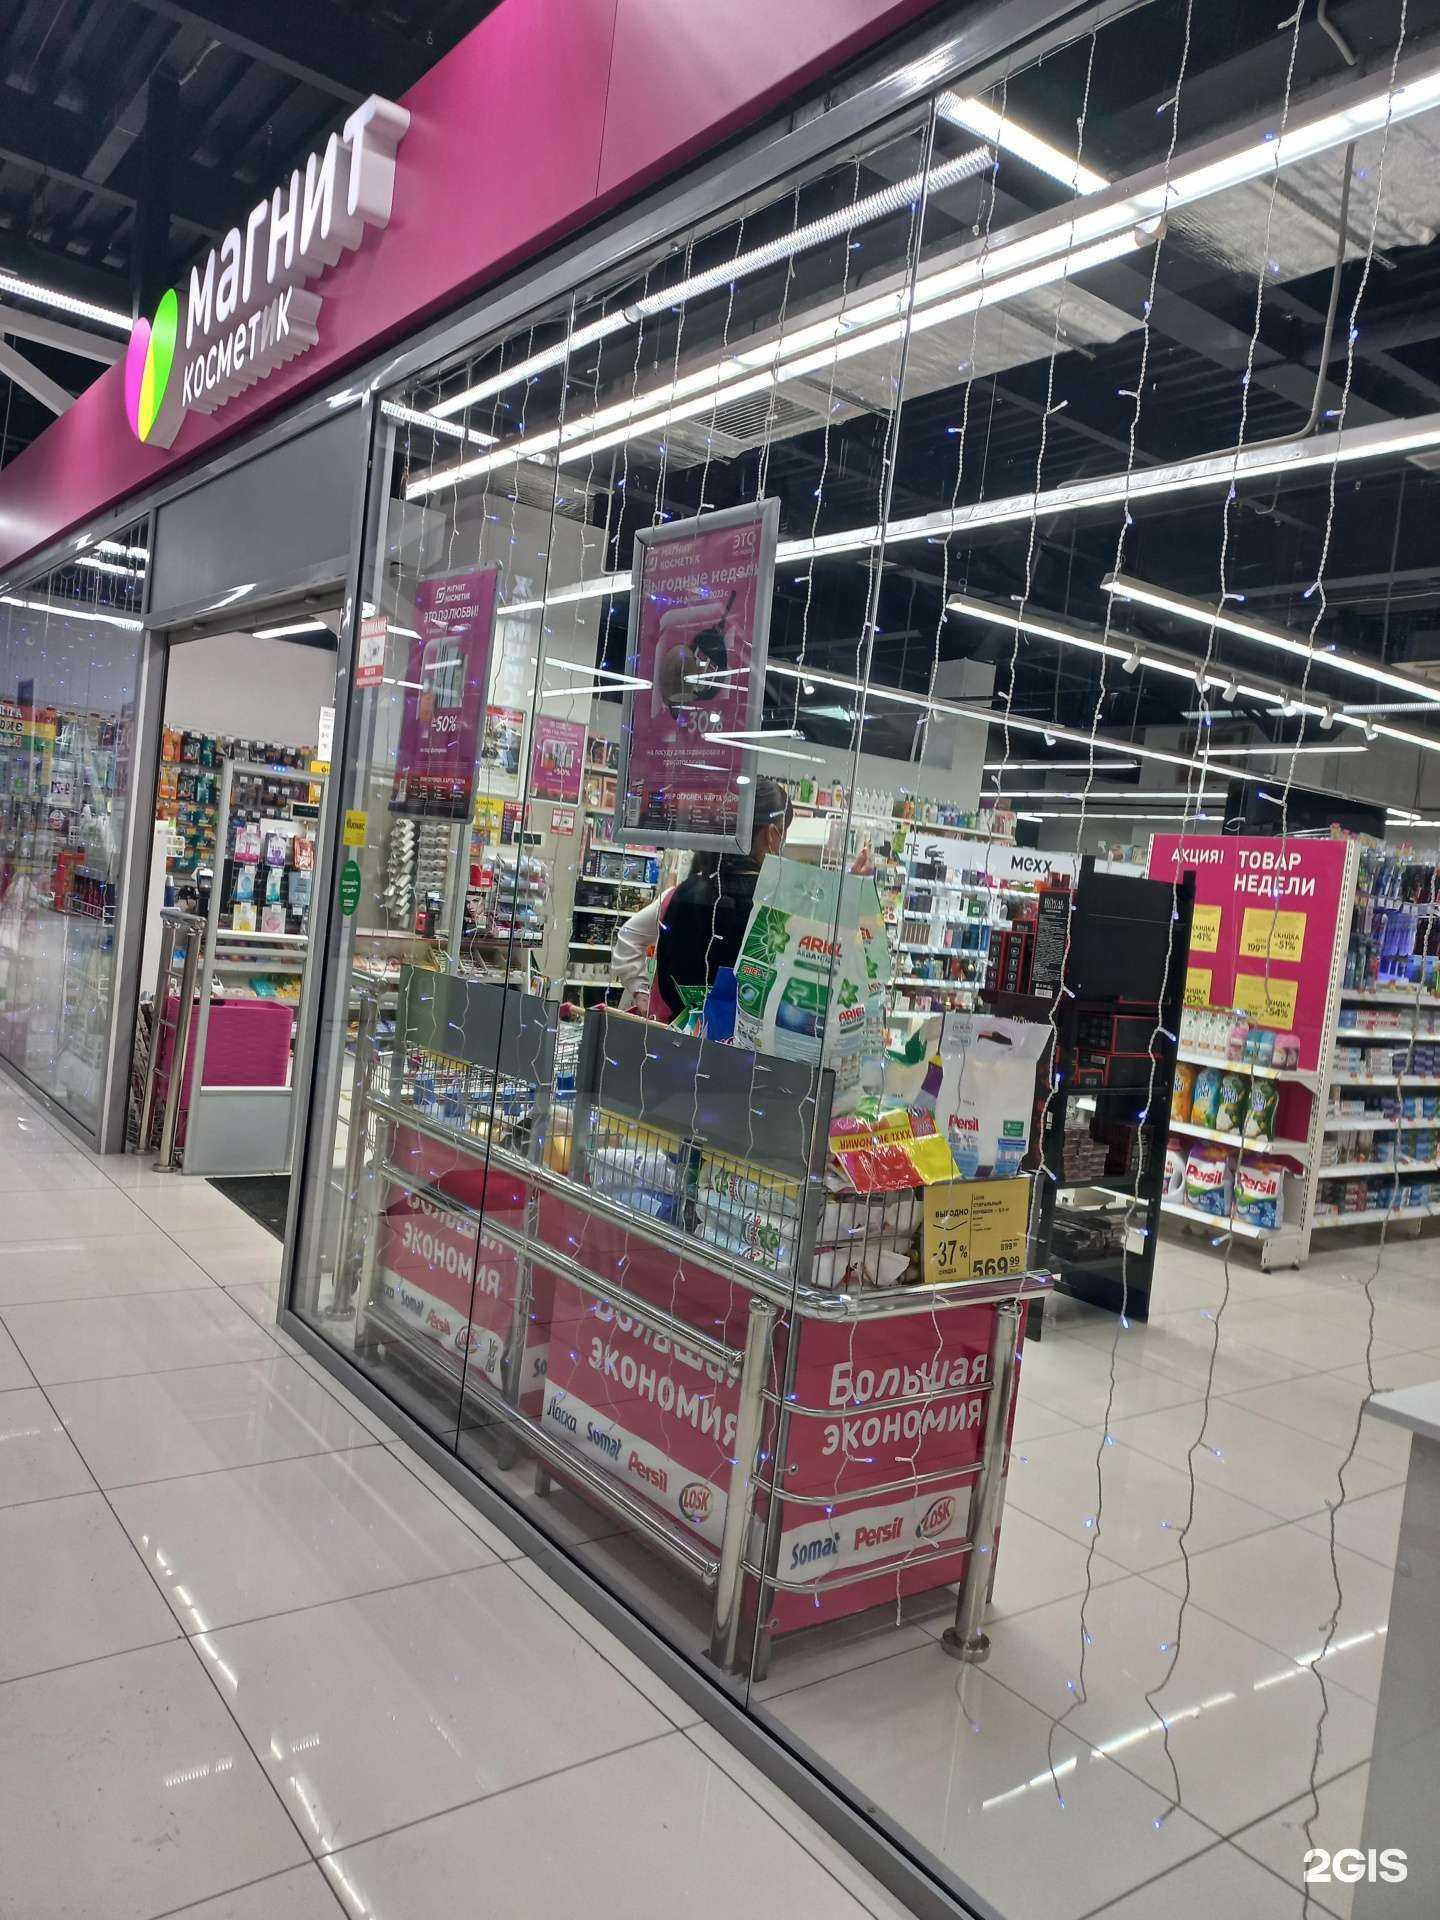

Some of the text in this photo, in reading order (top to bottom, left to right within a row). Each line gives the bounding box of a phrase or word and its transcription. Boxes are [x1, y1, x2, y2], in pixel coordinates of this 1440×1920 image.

[1171, 848, 1302, 872] АКЦИЯ! ТОВАР
[1233, 874, 1316, 897] НЕДЕЛИ
[947, 1113, 980, 1132] Persil
[1186, 1164, 1225, 1185] Persil
[1239, 1172, 1277, 1195] Persil
[935, 1208, 968, 1219] ВЫГОДНО
[829, 1353, 988, 1406] Большая
[547, 1396, 577, 1434] Ласка
[587, 1421, 622, 1462] Somat
[628, 1450, 668, 1494] Persil
[790, 1533, 840, 1570] Somat
[853, 1516, 904, 1552] Persil
